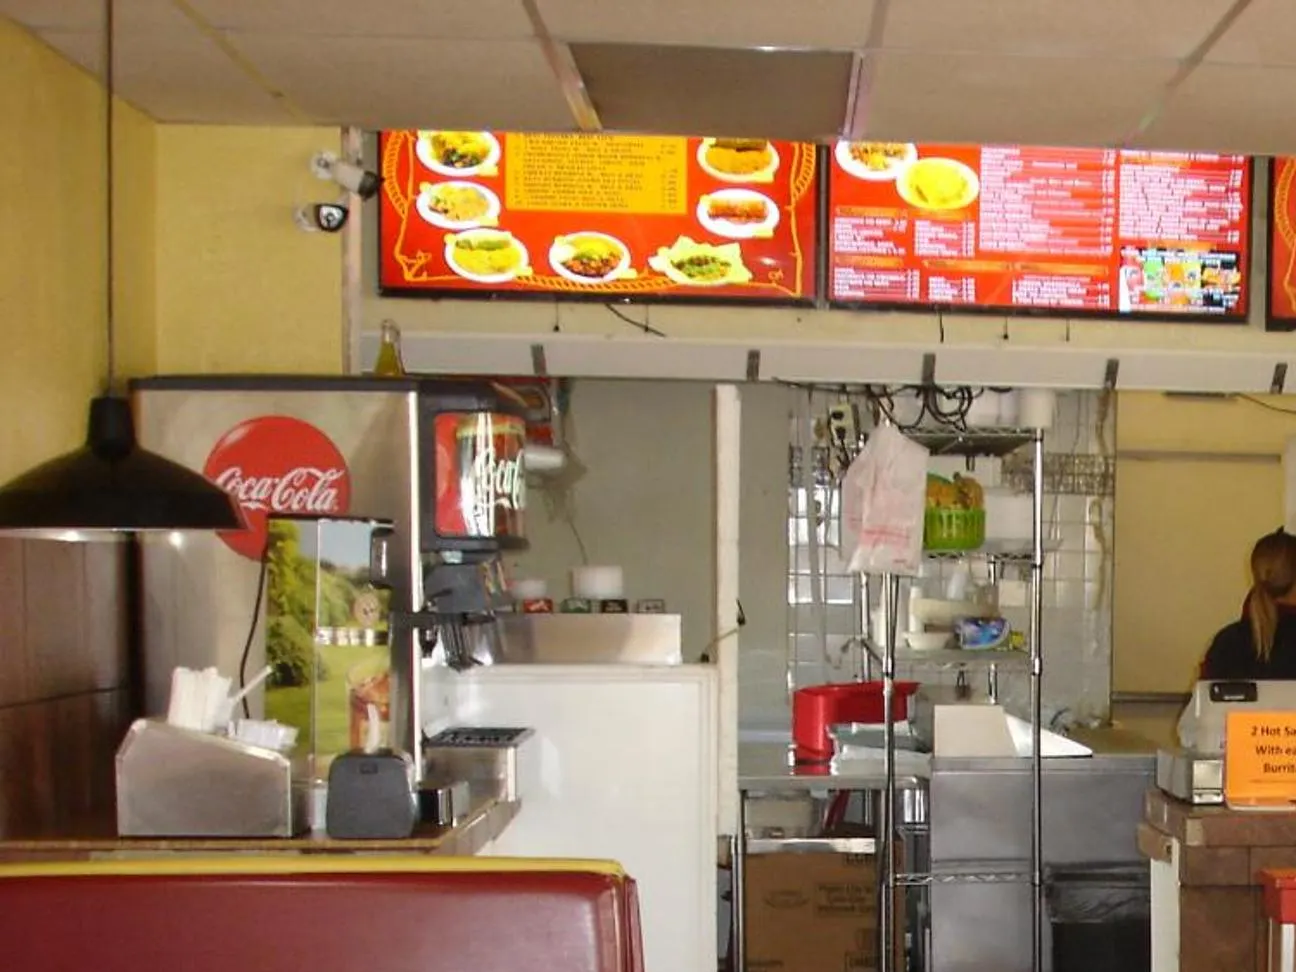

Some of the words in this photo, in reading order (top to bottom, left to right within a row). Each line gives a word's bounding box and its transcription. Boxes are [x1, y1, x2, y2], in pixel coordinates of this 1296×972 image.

[215, 467, 345, 511] Coca-Cola
[1250, 725, 1258, 737] 2
[1260, 725, 1281, 737] Hot
[1255, 744, 1283, 756] With
